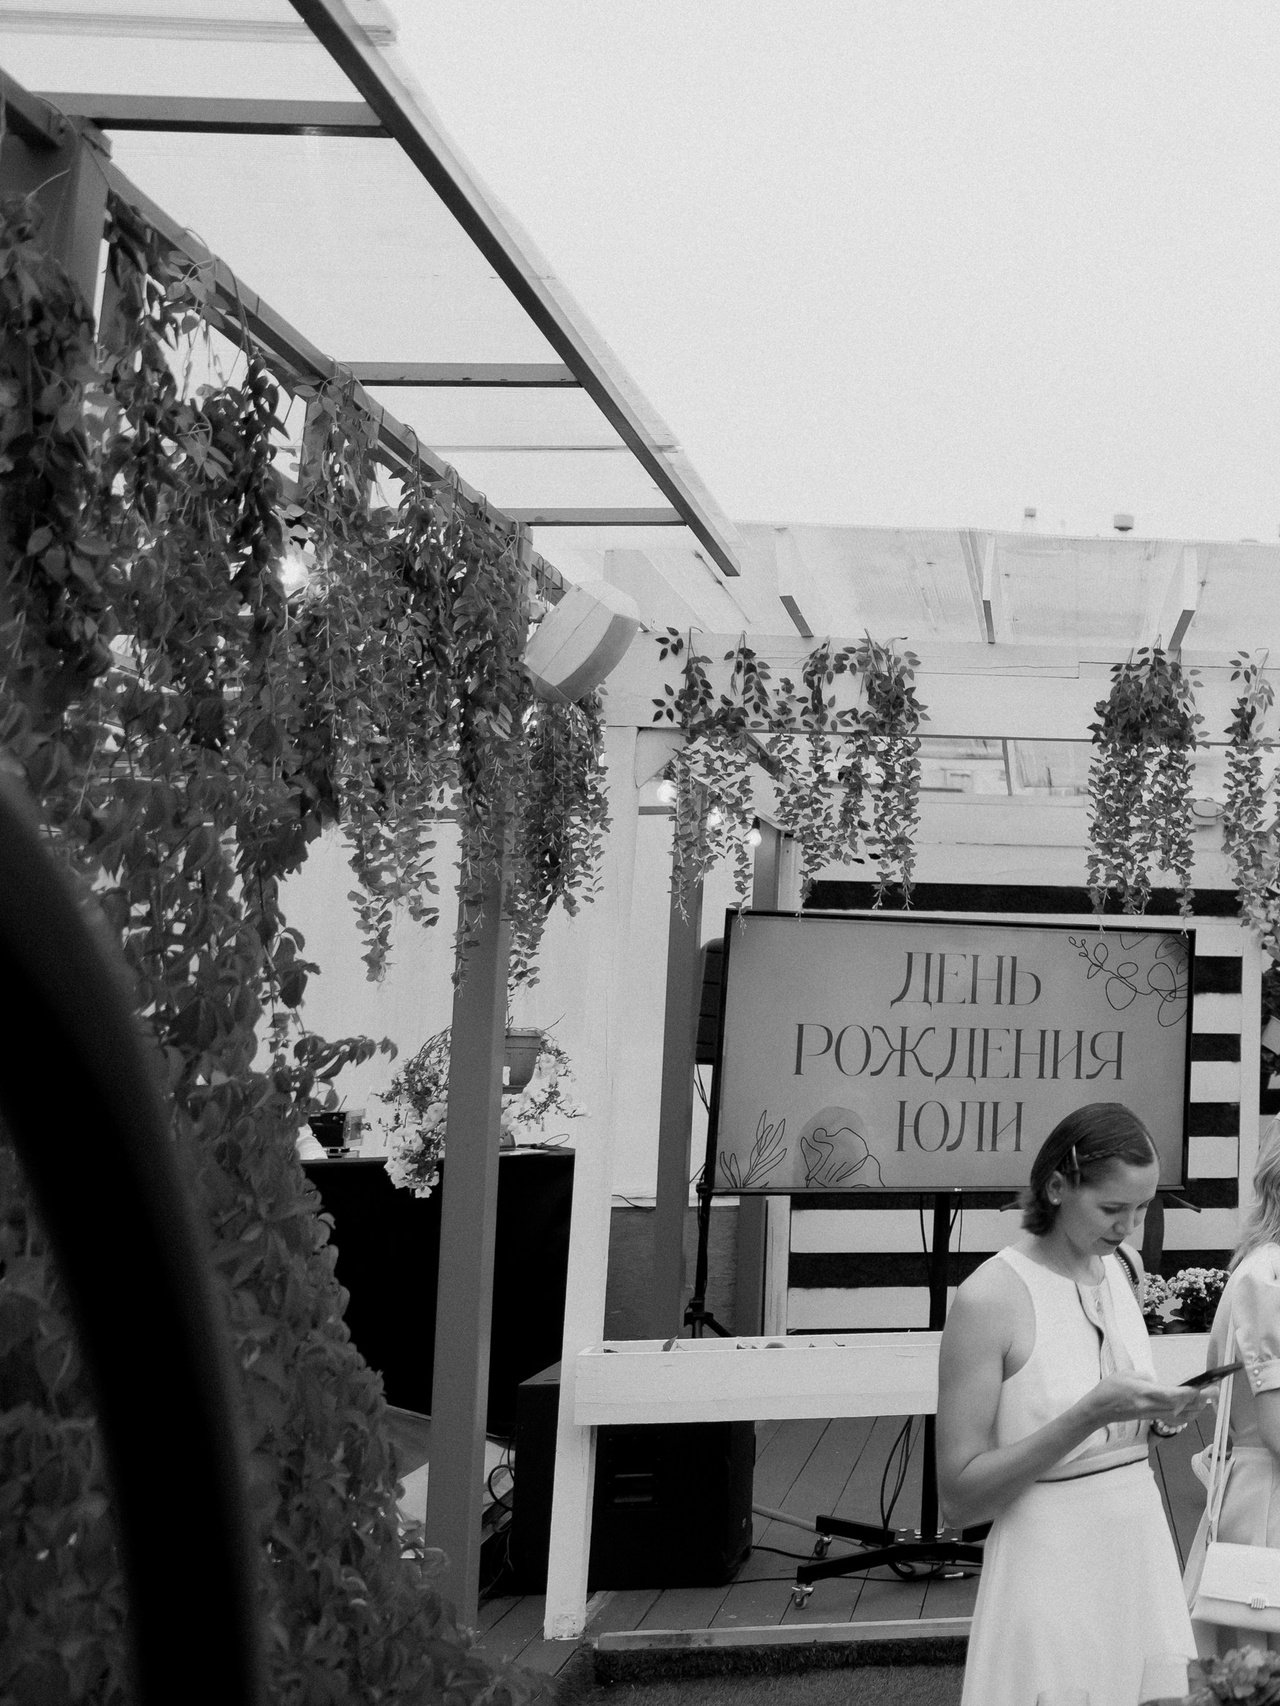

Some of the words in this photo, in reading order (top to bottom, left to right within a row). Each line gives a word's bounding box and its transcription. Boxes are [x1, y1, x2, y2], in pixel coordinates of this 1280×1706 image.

[890, 951, 1042, 1010] ДЕНЬ
[793, 1023, 1125, 1084] РОЖДЕНИЯ
[896, 1100, 1024, 1152] ЮЛИ
